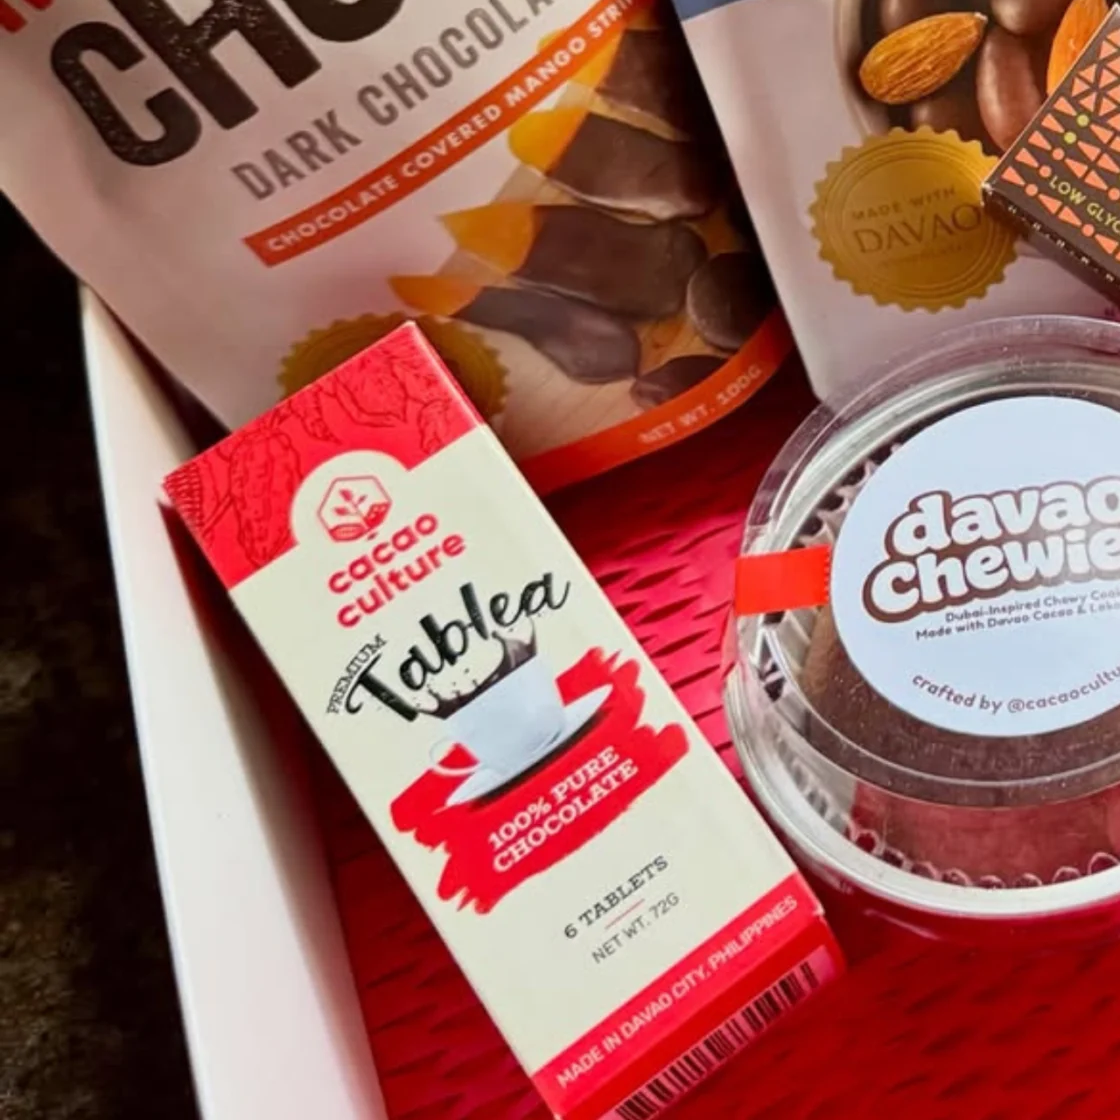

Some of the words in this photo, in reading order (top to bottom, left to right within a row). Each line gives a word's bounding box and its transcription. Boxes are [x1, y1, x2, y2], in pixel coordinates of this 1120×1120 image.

[231, 109, 362, 201] DARK
[267, 175, 399, 253] CHOCOLATE
[401, 103, 503, 179] COVERED
[504, 34, 587, 109] MANGO
[854, 203, 982, 255] DAVAO
[1049, 175, 1086, 205] LOW
[638, 421, 676, 445] NET
[327, 512, 439, 595] cacao
[337, 533, 467, 629] culture
[345, 572, 571, 722] Tablea
[916, 626, 952, 641] Made
[955, 618, 985, 633] with
[987, 614, 1029, 629] Davao
[1033, 608, 1073, 622] Cacao
[1077, 604, 1086, 615] &
[945, 595, 1040, 623] Dubai-Inspired
[1043, 592, 1086, 611] Chewy
[326, 633, 388, 714] PREMIUM
[913, 674, 977, 708] crafted
[980, 695, 1002, 715] by
[488, 797, 552, 851] 100%
[551, 746, 620, 803] PURE
[492, 757, 639, 873] CHOCOLATE
[564, 923, 578, 940] 6
[578, 854, 670, 928] TABLETS
[591, 936, 624, 965] NET
[622, 918, 652, 943] WT.
[649, 891, 681, 921] 72G
[556, 1048, 604, 1089] MADE
[602, 1033, 623, 1054] IN
[620, 992, 673, 1041] DAVAO
[708, 895, 799, 972] PHILIPPINES
